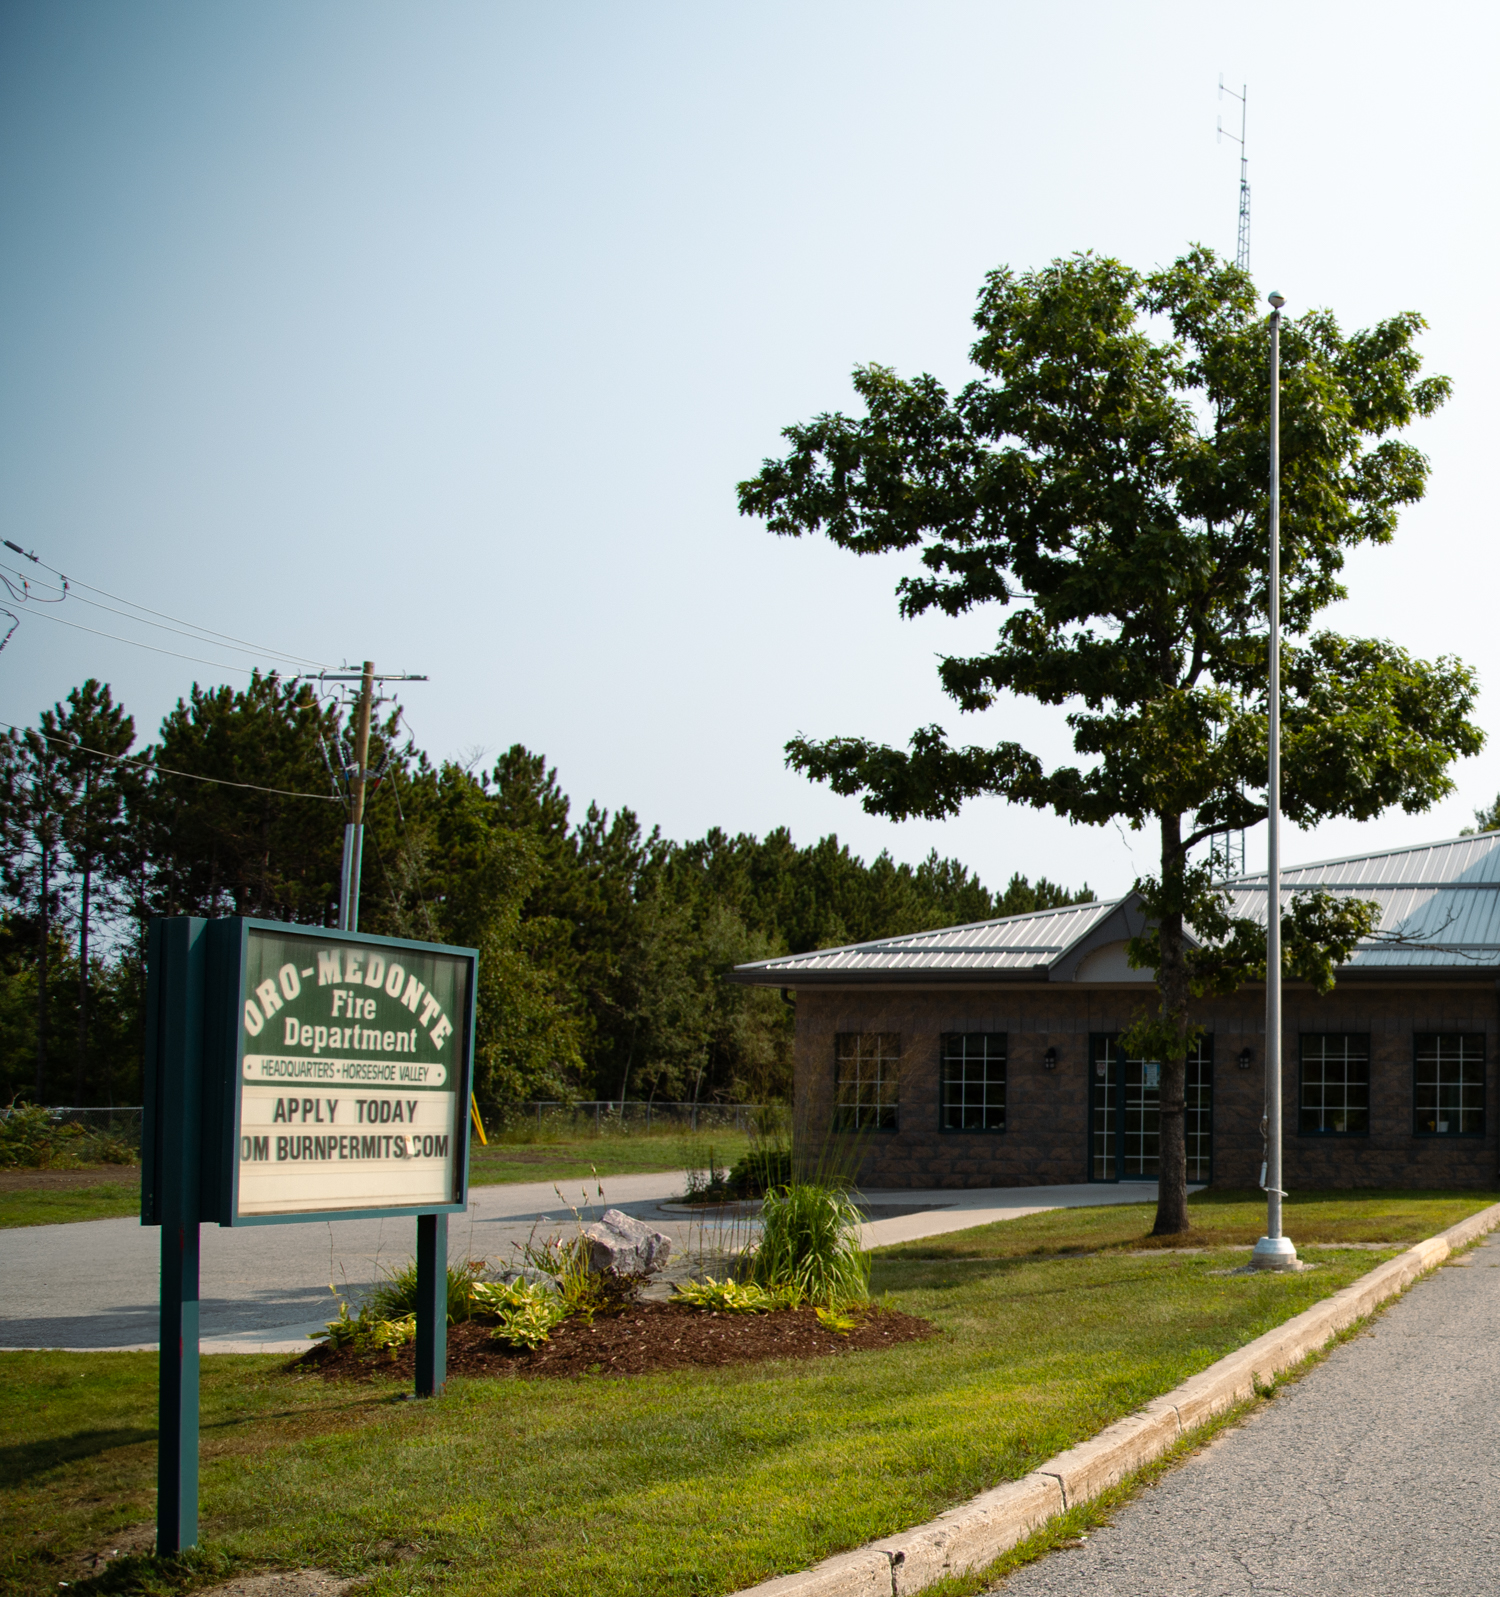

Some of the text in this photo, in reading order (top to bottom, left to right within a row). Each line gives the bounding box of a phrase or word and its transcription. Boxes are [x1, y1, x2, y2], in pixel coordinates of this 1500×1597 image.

[243, 950, 453, 1051] ORO-MEDONTE
[331, 989, 377, 1020] Fire
[284, 1017, 417, 1053] Department
[261, 1059, 430, 1082] HEADQUARTERS HORSESHOE VALLEY
[273, 1098, 418, 1123] APPLY TODAY
[277, 1135, 449, 1161] BURNPERMITSCOM
